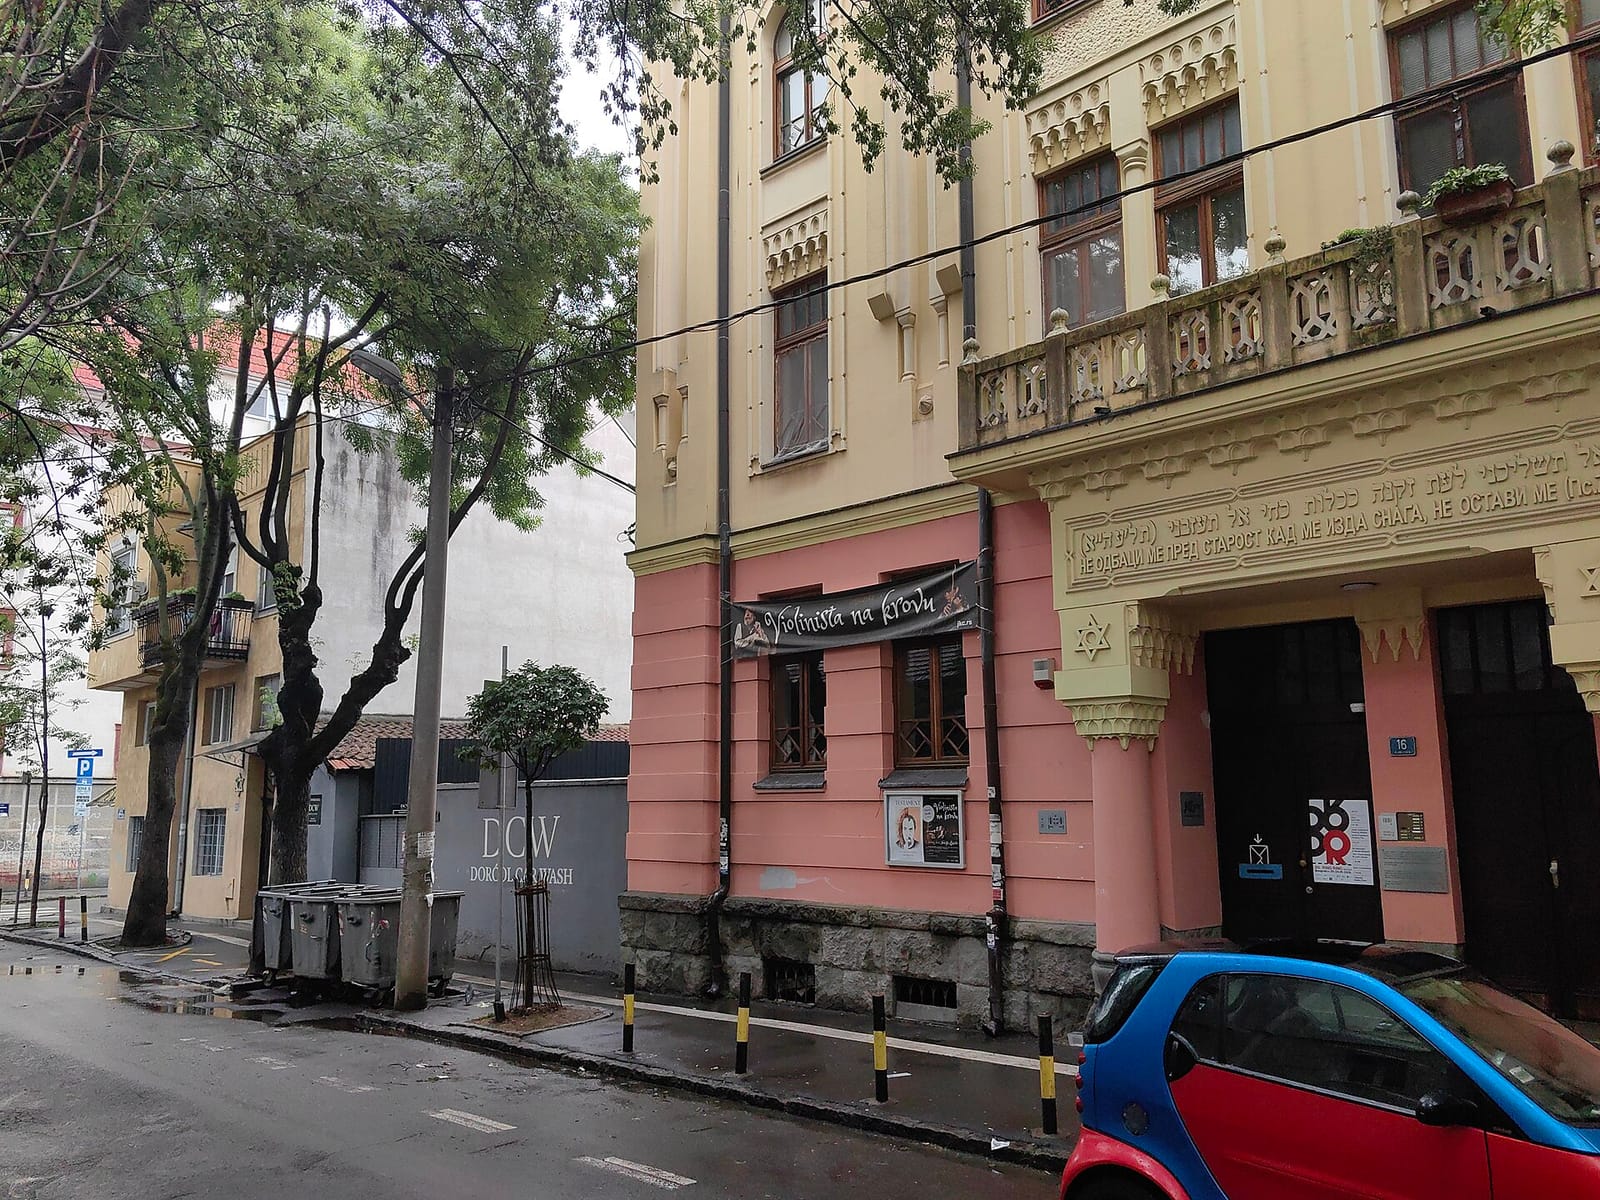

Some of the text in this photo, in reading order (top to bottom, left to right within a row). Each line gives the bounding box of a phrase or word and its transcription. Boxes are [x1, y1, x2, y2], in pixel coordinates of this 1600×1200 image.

[1371, 477, 1416, 507] זקנה
[1080, 557, 1094, 576] НЕ
[1096, 547, 1144, 575] ОДБАЦИ
[1147, 545, 1166, 565] МЕ
[1167, 541, 1200, 562] ПРЕД
[1203, 528, 1262, 556] СТАРОСТ
[1266, 522, 1298, 547] КАД
[1301, 519, 1323, 541] МЕ
[1326, 511, 1369, 538] ИЗДА
[1373, 502, 1428, 530] СНАГА,
[1433, 498, 1453, 521] НЕ
[1459, 487, 1528, 516] ОСТАВИ
[1533, 481, 1559, 506] МЕ
[1225, 502, 1250, 529] אל
[764, 587, 937, 645] Violinista na krovu
[1396, 738, 1407, 751] 16
[80, 759, 91, 776] P
[482, 815, 561, 859] DCW
[515, 867, 538, 884] CR
